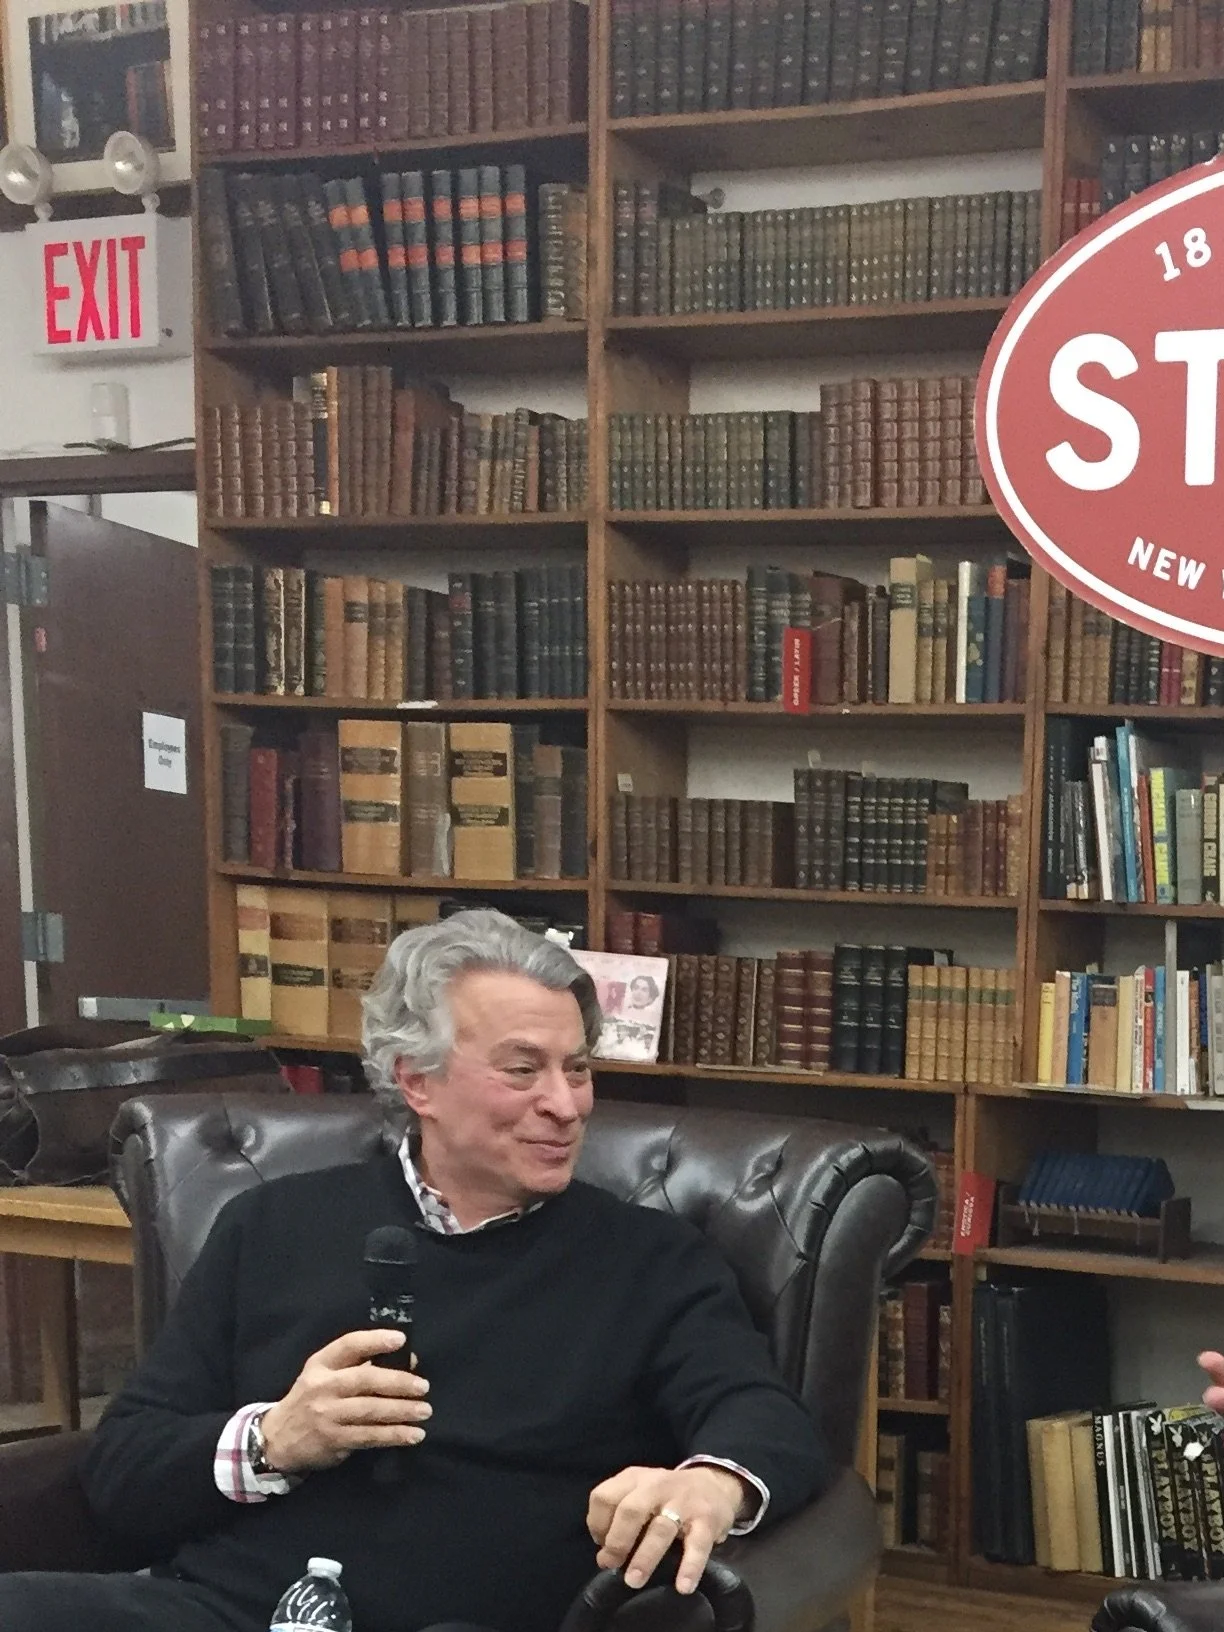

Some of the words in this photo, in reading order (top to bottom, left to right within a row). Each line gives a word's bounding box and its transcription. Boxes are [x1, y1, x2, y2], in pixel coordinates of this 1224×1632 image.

[1155, 229, 1212, 282] 18
[44, 236, 146, 344] EXIT
[1128, 536, 1206, 592] NEW
[1203, 842, 1217, 877] CRAIG
[1094, 1415, 1105, 1467] MAGNUS
[1152, 1449, 1177, 1541] PLAYBOY
[1174, 1459, 1199, 1551] PLAYBOY
